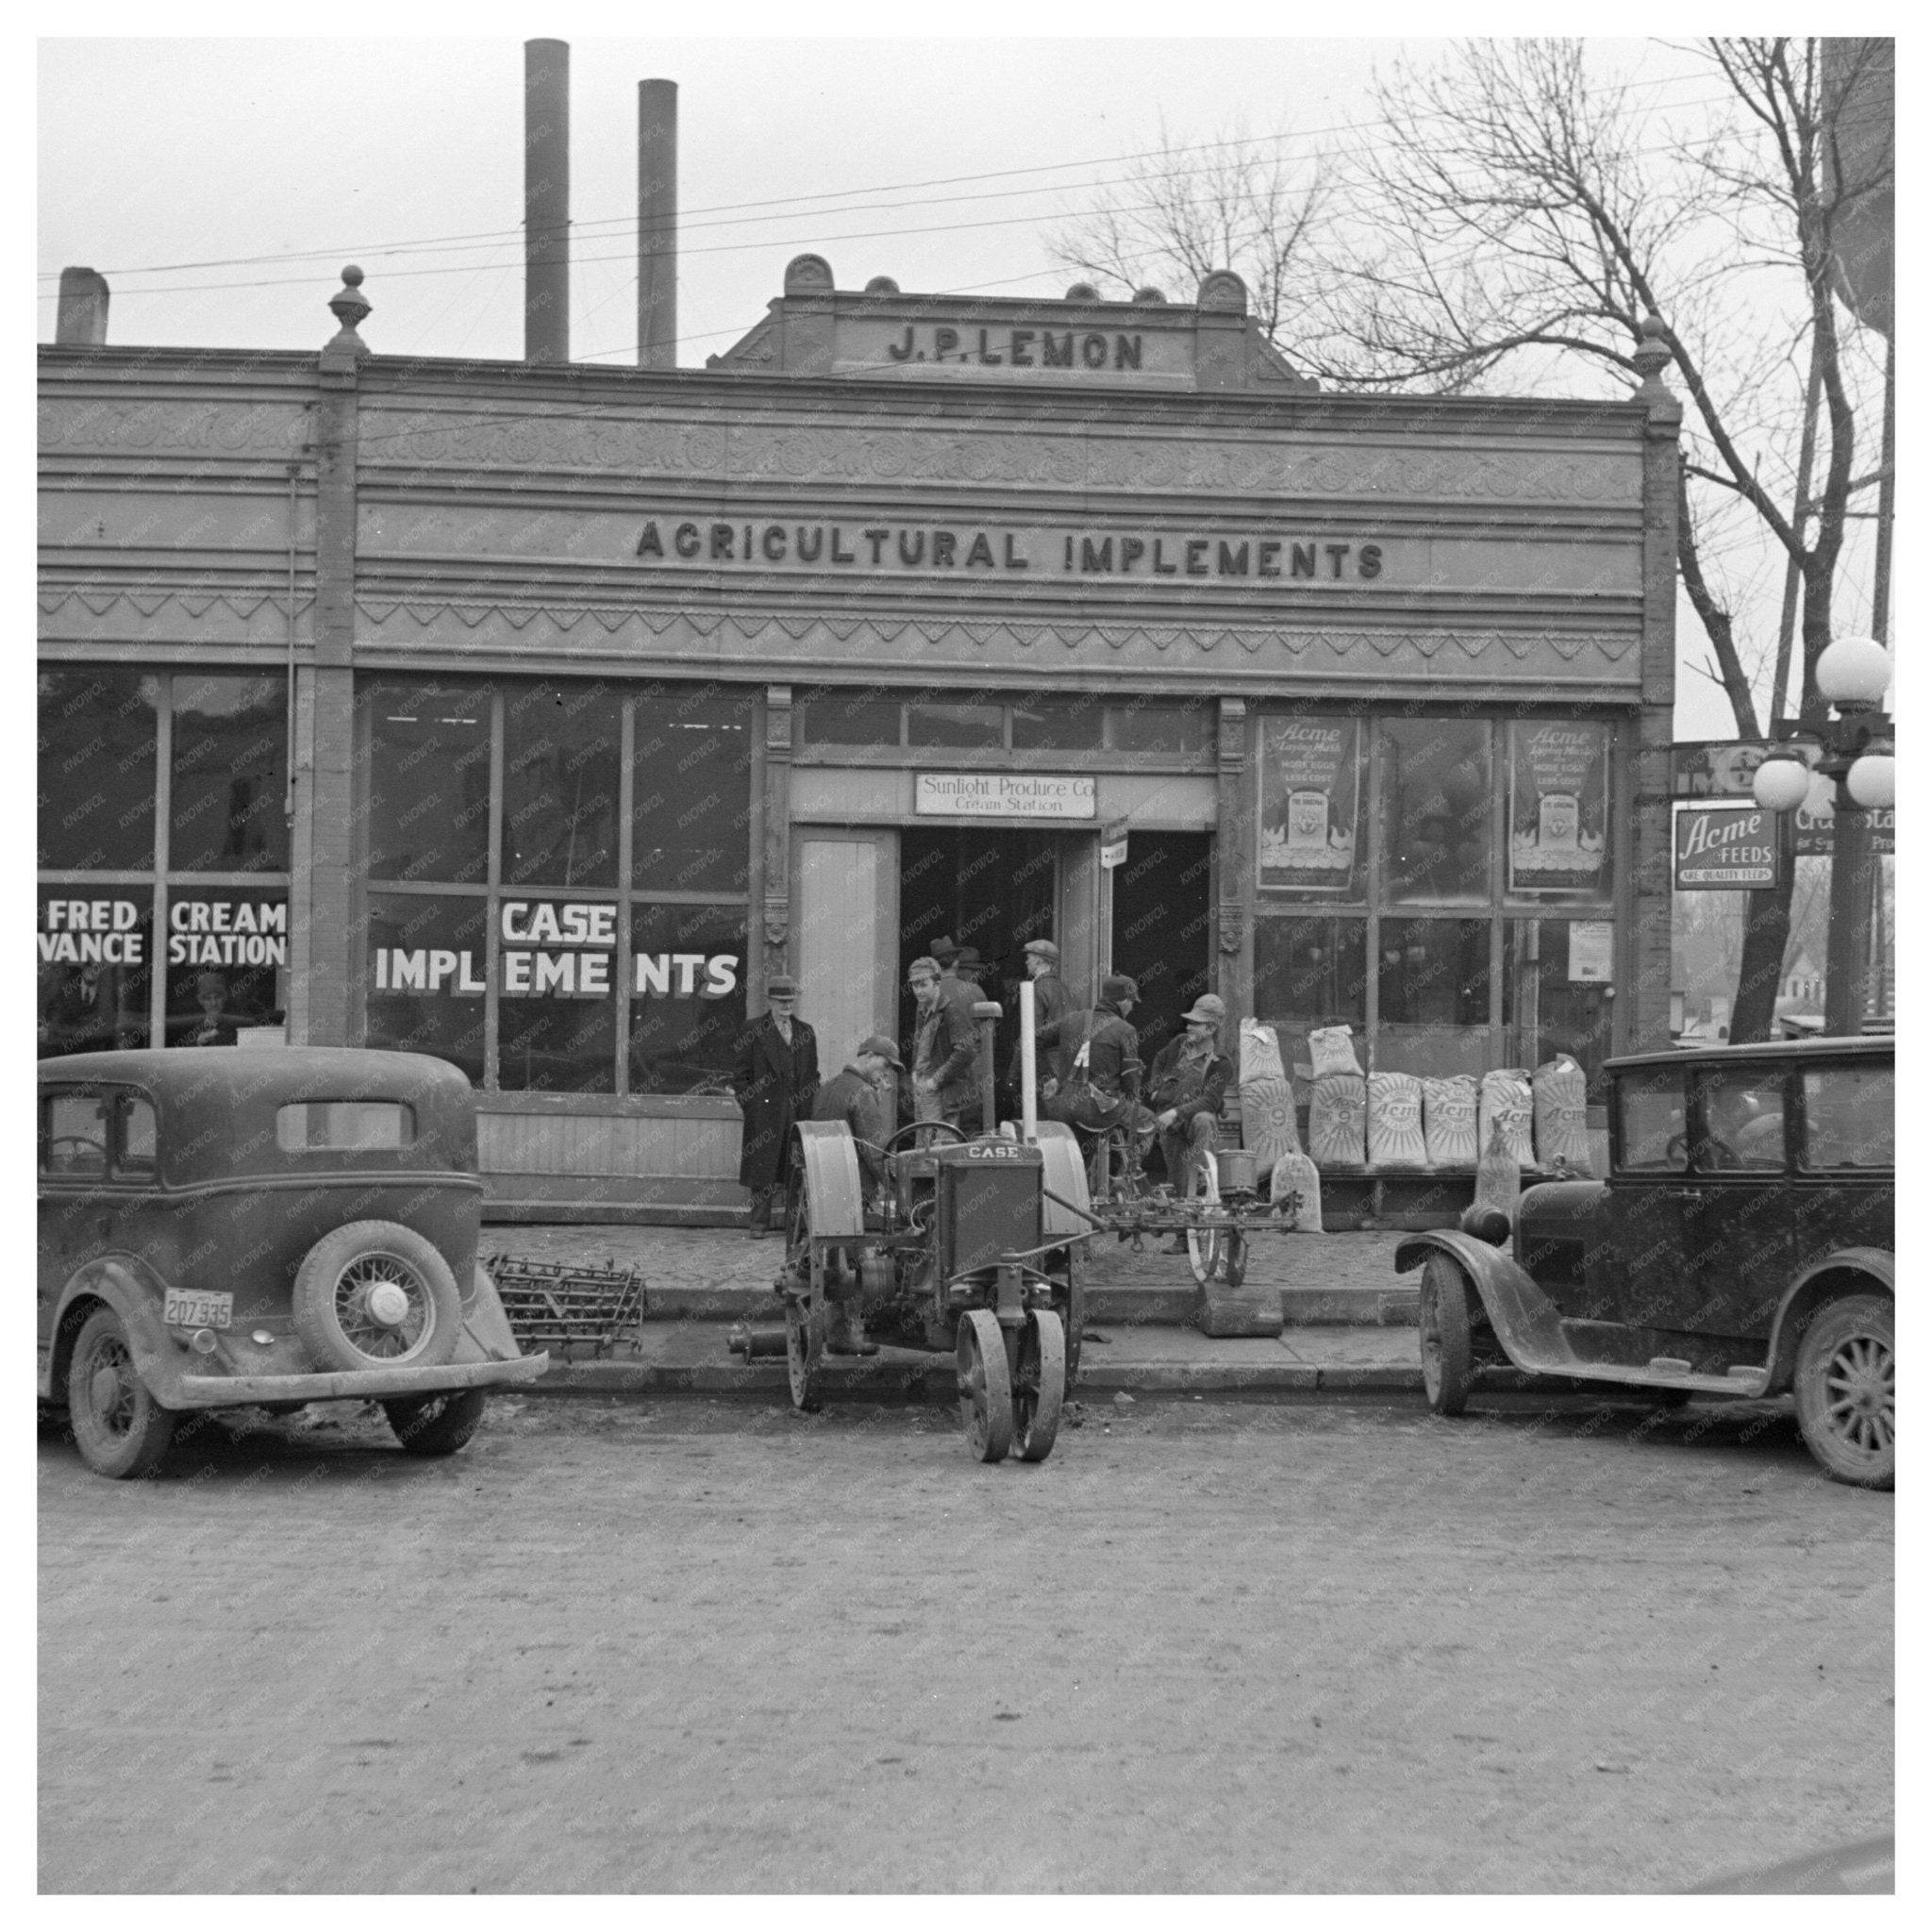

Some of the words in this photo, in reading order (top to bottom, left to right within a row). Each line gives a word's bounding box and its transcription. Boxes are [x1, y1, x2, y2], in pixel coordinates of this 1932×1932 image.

[637, 521, 1028, 571] AGRICULTURAL
[1065, 534, 1383, 578] IMPLEMENTS
[1276, 724, 1341, 741] Acme
[1527, 726, 1591, 744] Acme
[1310, 761, 1336, 770] EGGS
[924, 776, 990, 798] Sunlight
[999, 777, 1067, 797] Produce
[1285, 774, 1307, 782] LESS
[1308, 774, 1332, 782] COST
[956, 795, 1001, 810] Cream
[1007, 797, 1063, 811] Station
[1678, 813, 1762, 860] Acme
[1721, 846, 1773, 864] FEEDS
[1683, 870, 1699, 880] ARE
[1703, 869, 1738, 880] QUALITY
[1742, 869, 1770, 880] FEEDS
[47, 900, 138, 931] FRED
[171, 901, 286, 933] CREAM
[502, 902, 617, 944] CASE
[37, 932, 142, 963] VANCE
[168, 933, 287, 965] STATION
[1338, 1110, 1351, 1124] 9
[968, 1145, 1019, 1158] CASE
